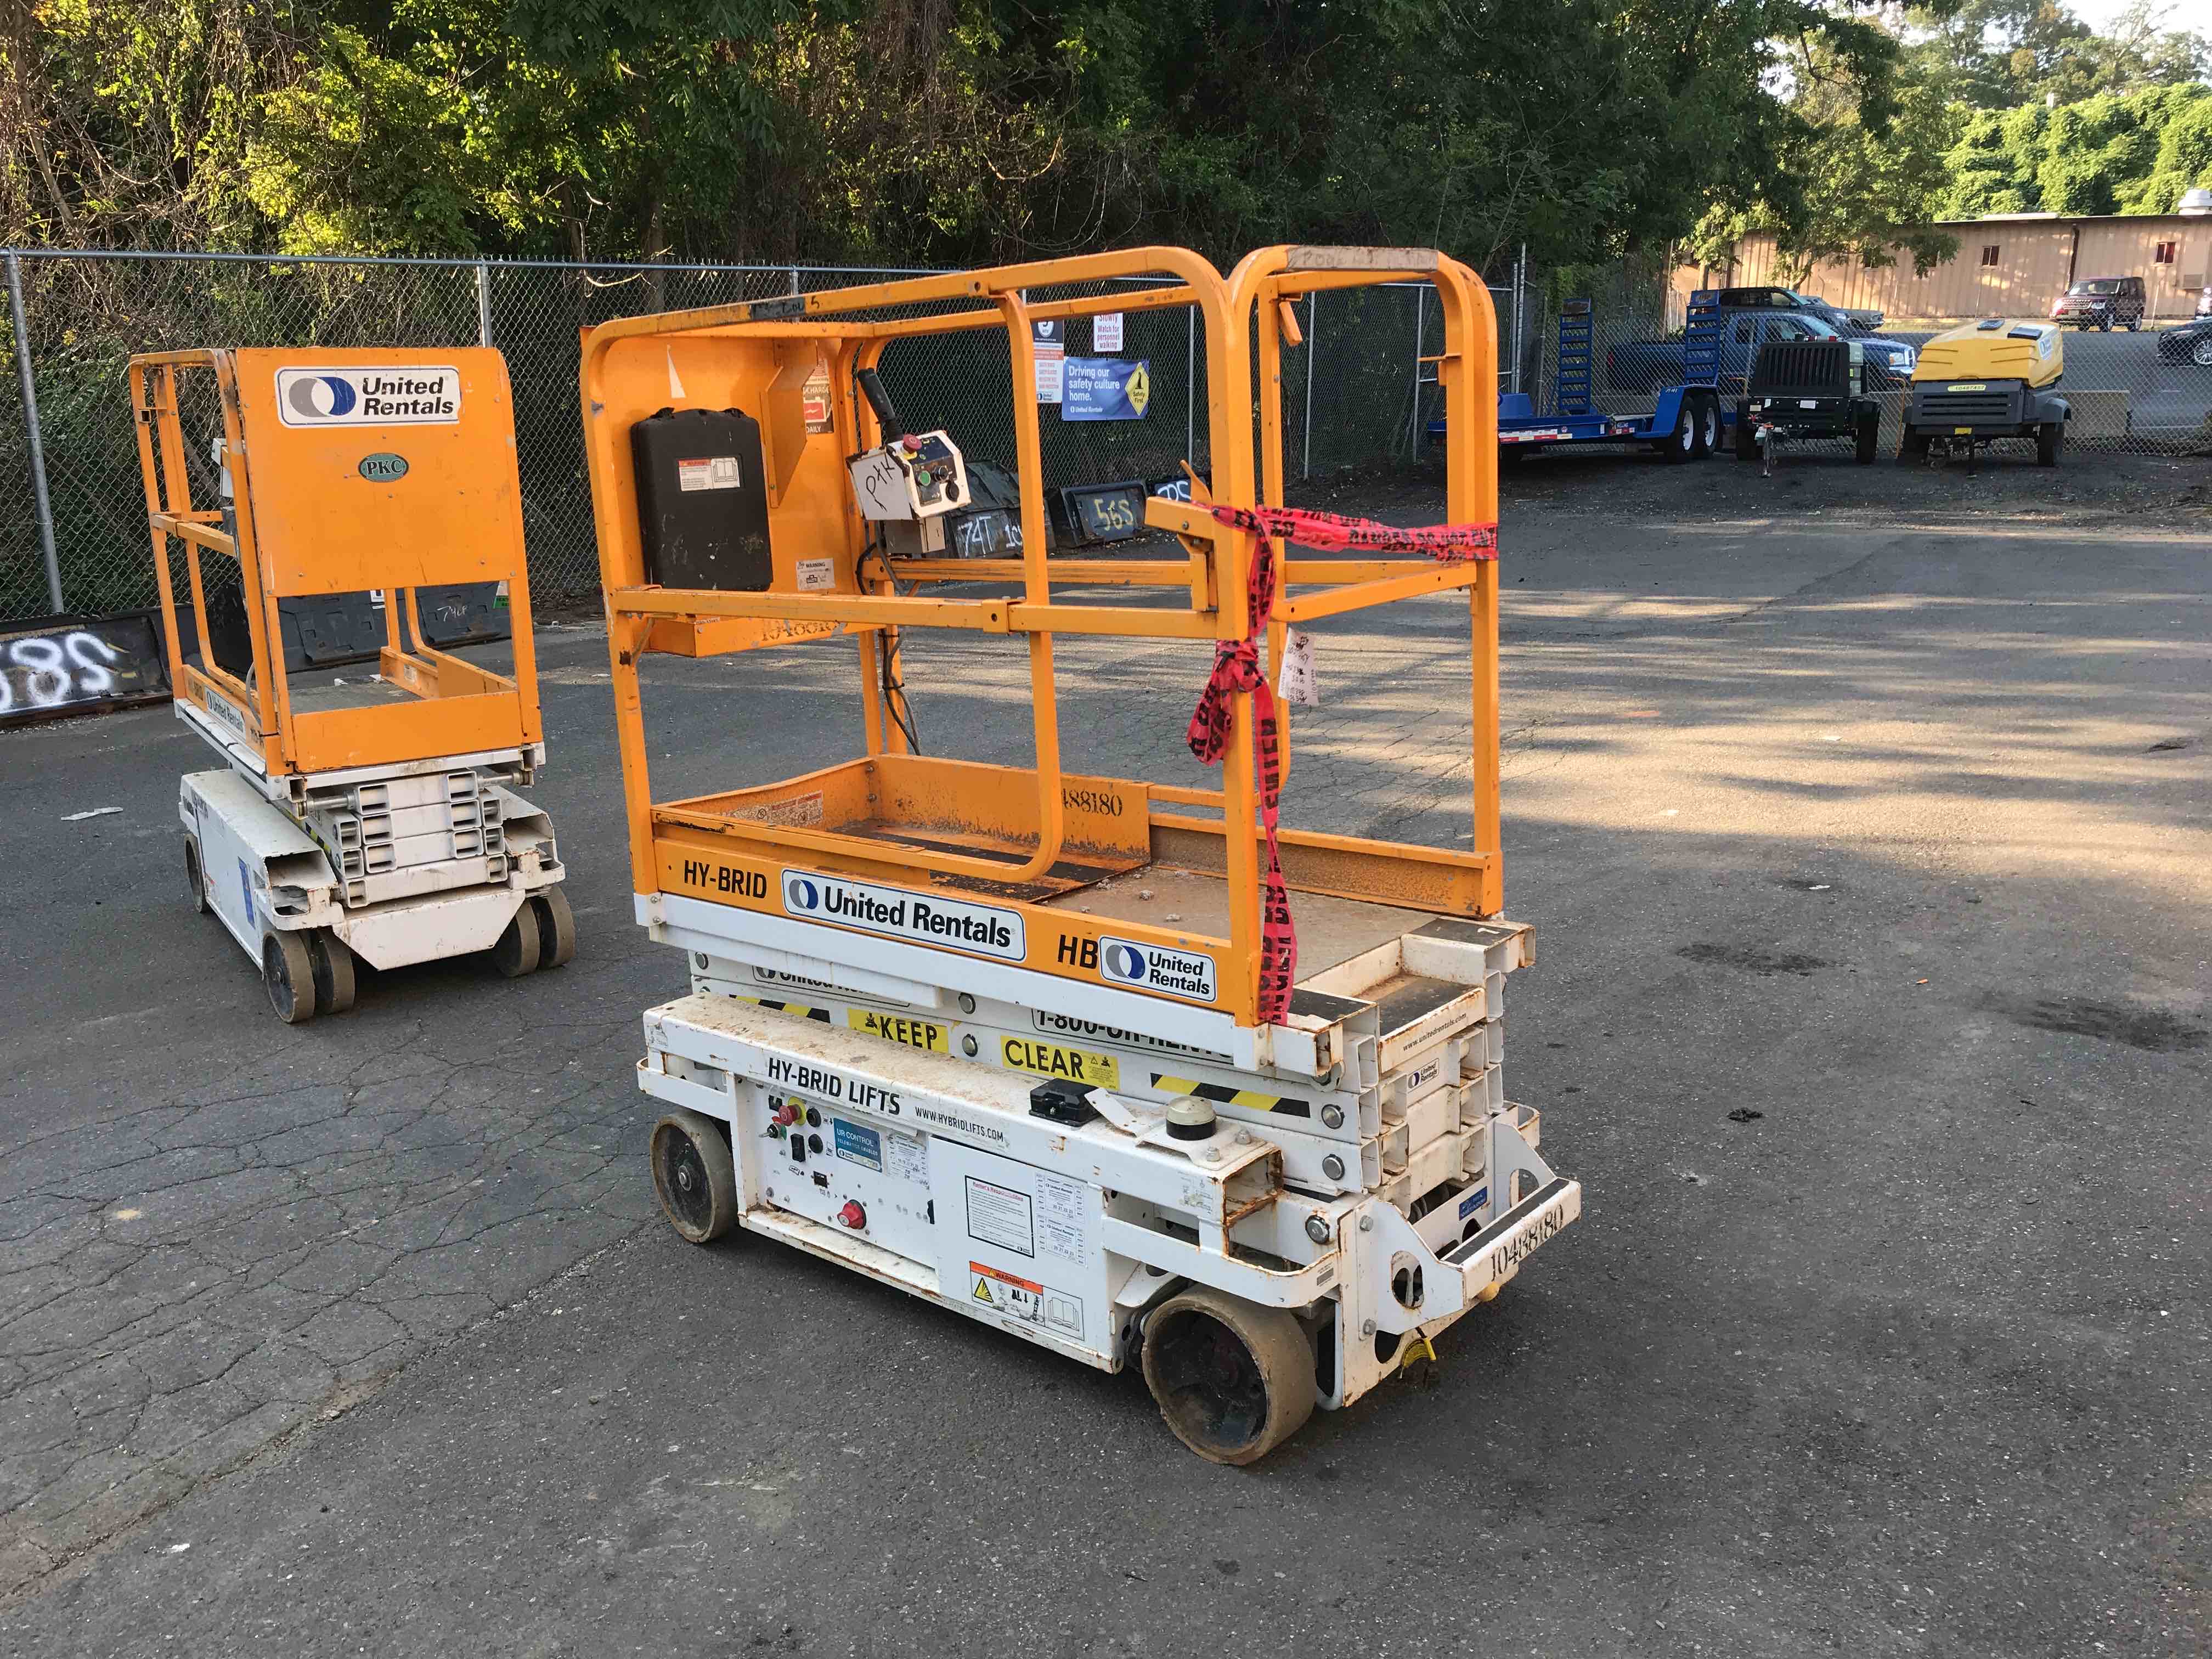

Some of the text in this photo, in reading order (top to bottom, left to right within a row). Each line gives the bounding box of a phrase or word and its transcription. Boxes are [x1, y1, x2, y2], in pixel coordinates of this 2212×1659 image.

[1098, 334, 1120, 342] personnel
[1069, 365, 1110, 379] Driving our
[363, 376, 443, 395] United
[1069, 378, 1120, 391] safety culture
[1069, 391, 1092, 401] home.
[363, 397, 454, 415] Rentals
[366, 460, 403, 475] PKC
[684, 860, 767, 899] HY-BRID
[825, 885, 1011, 948] United Rentals
[1149, 952, 1204, 977] United
[1150, 970, 1210, 995] Rentals
[879, 1014, 938, 1050] KEEP
[1403, 1013, 1466, 1051] www.unitedrentals.com
[1005, 1039, 1085, 1080] CLEAR
[1420, 1062, 1436, 1075] United
[1420, 1069, 1438, 1083] Rentals
[768, 1057, 901, 1115] HY-BRID LIFTS
[915, 1105, 1004, 1143] WWW.HYBRIDLIFTS.COM
[836, 1127, 874, 1147] UR CONTROL
[995, 1272, 1025, 1287] WARNING
